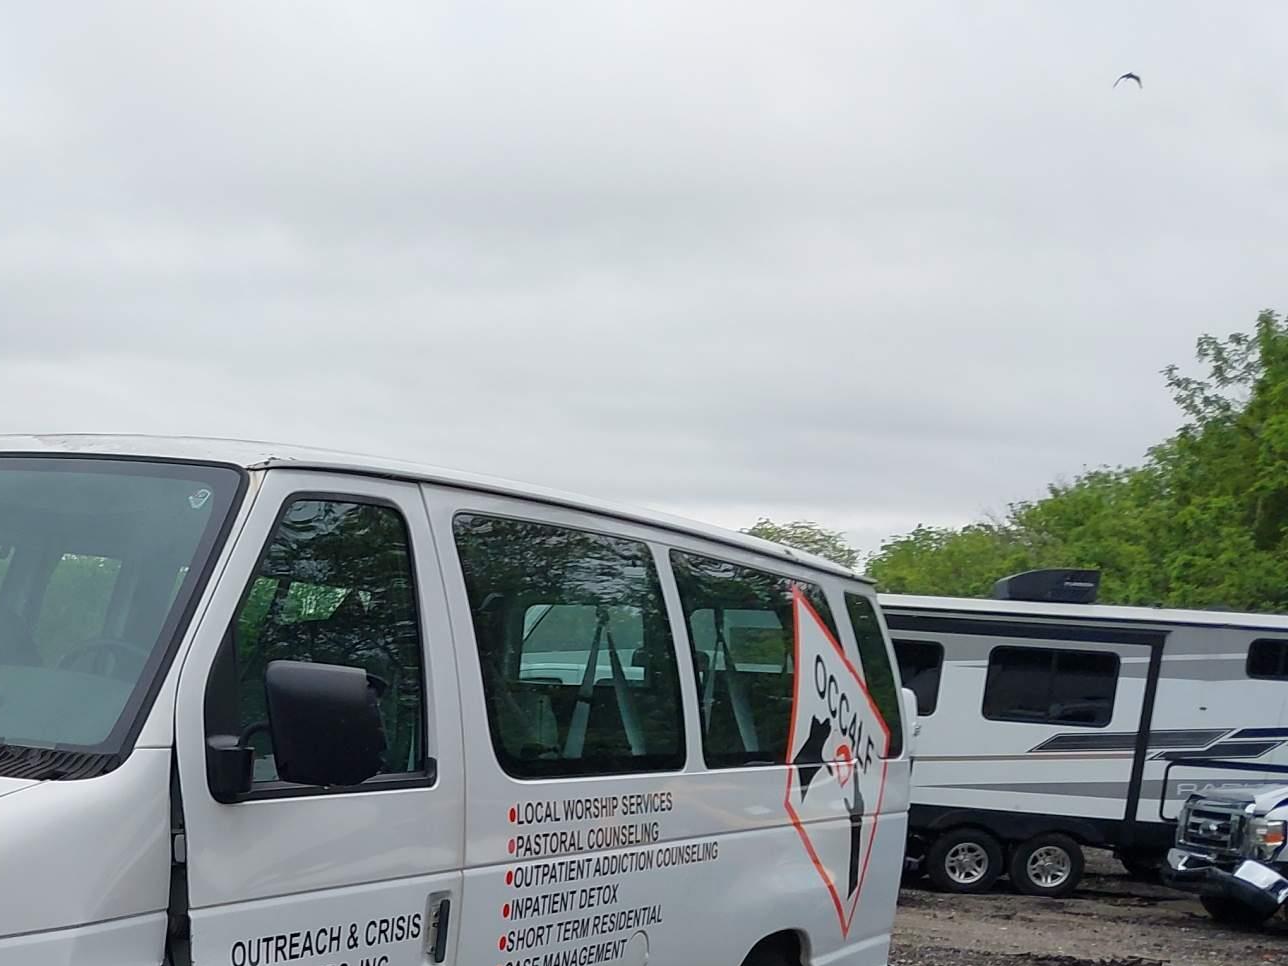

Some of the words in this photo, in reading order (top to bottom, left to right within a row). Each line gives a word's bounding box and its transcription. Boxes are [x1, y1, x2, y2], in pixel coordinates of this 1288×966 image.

[516, 801, 560, 825] LOCAL
[563, 797, 618, 821] WORSHIP
[622, 792, 673, 816] SERVICES
[516, 832, 583, 857] PASTORAL
[587, 822, 659, 848] COUNSELING
[514, 858, 592, 888] OUTPATIENT
[593, 850, 653, 877] ADDICTION
[656, 842, 718, 868] COUNSELING
[511, 890, 576, 920] INPATIENT
[579, 884, 619, 910] DETOX
[347, 923, 359, 949] &
[365, 913, 421, 946] CRISIS
[506, 924, 553, 953] SHORT
[556, 917, 590, 942] TERM
[592, 904, 663, 935] RESIDENTIAL
